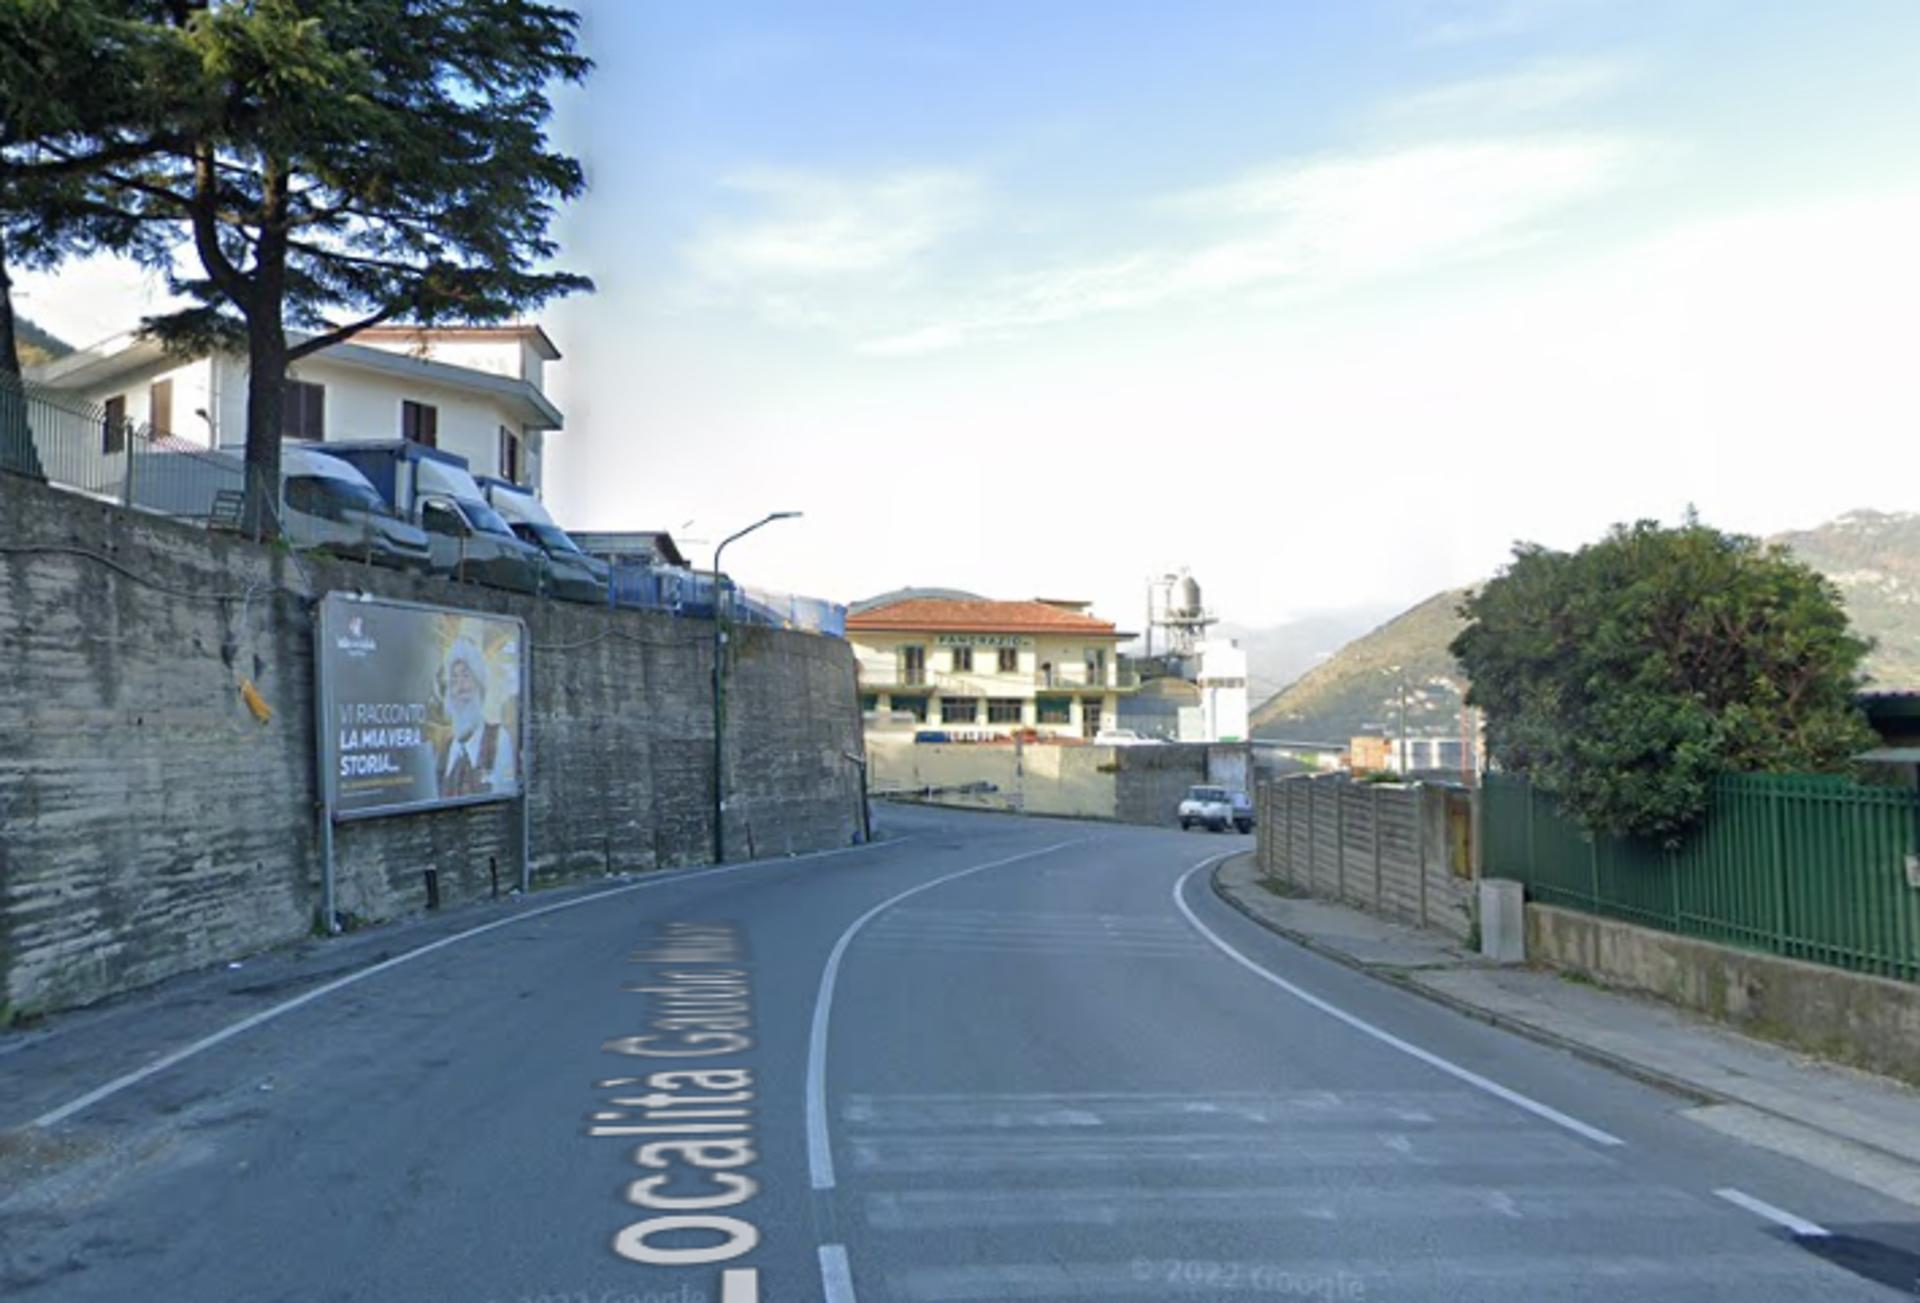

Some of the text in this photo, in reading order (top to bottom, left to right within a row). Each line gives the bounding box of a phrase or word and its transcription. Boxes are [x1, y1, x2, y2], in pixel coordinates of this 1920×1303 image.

[356, 703, 425, 724] RACCONTO
[340, 727, 421, 750] LA MIA VERA
